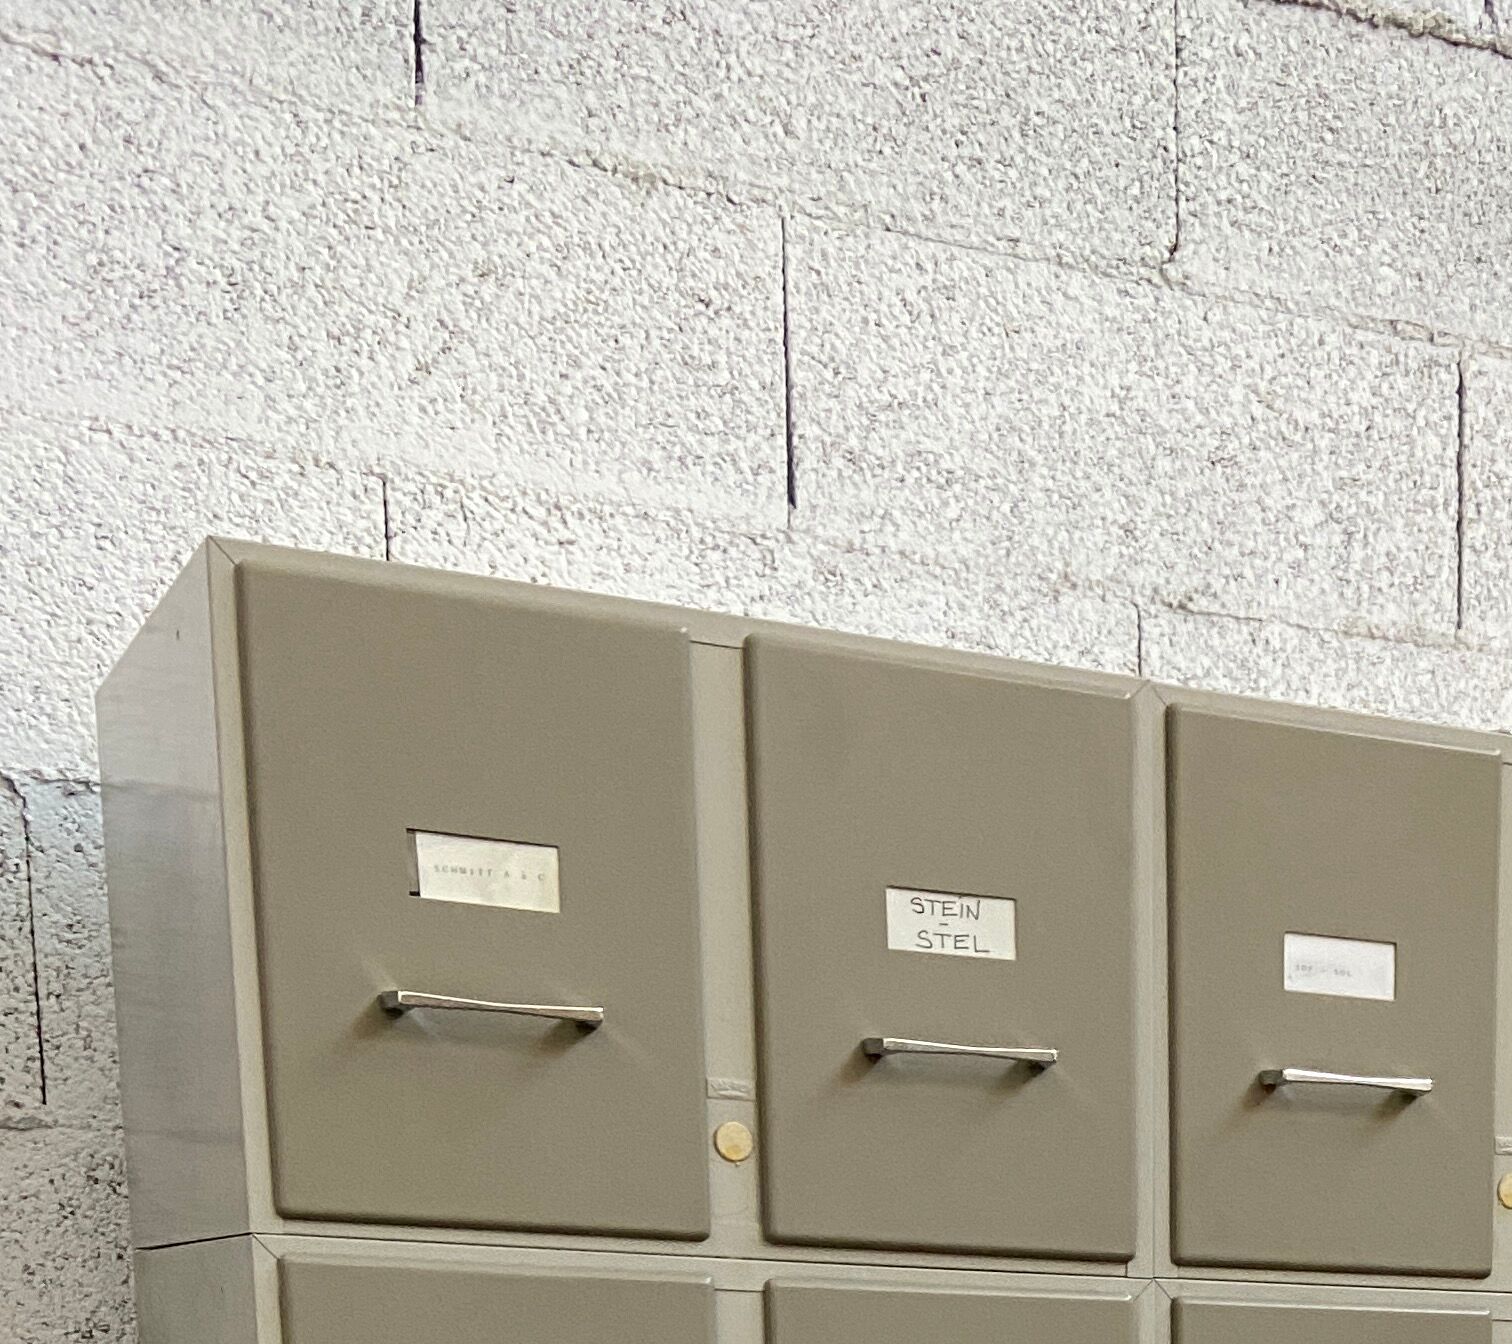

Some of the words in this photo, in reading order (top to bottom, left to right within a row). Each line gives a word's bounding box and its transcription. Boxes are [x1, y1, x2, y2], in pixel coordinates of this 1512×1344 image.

[433, 863, 492, 877] SCHMITT
[503, 870, 509, 879] A
[910, 893, 980, 921] STEIN
[914, 928, 991, 957] STEL
